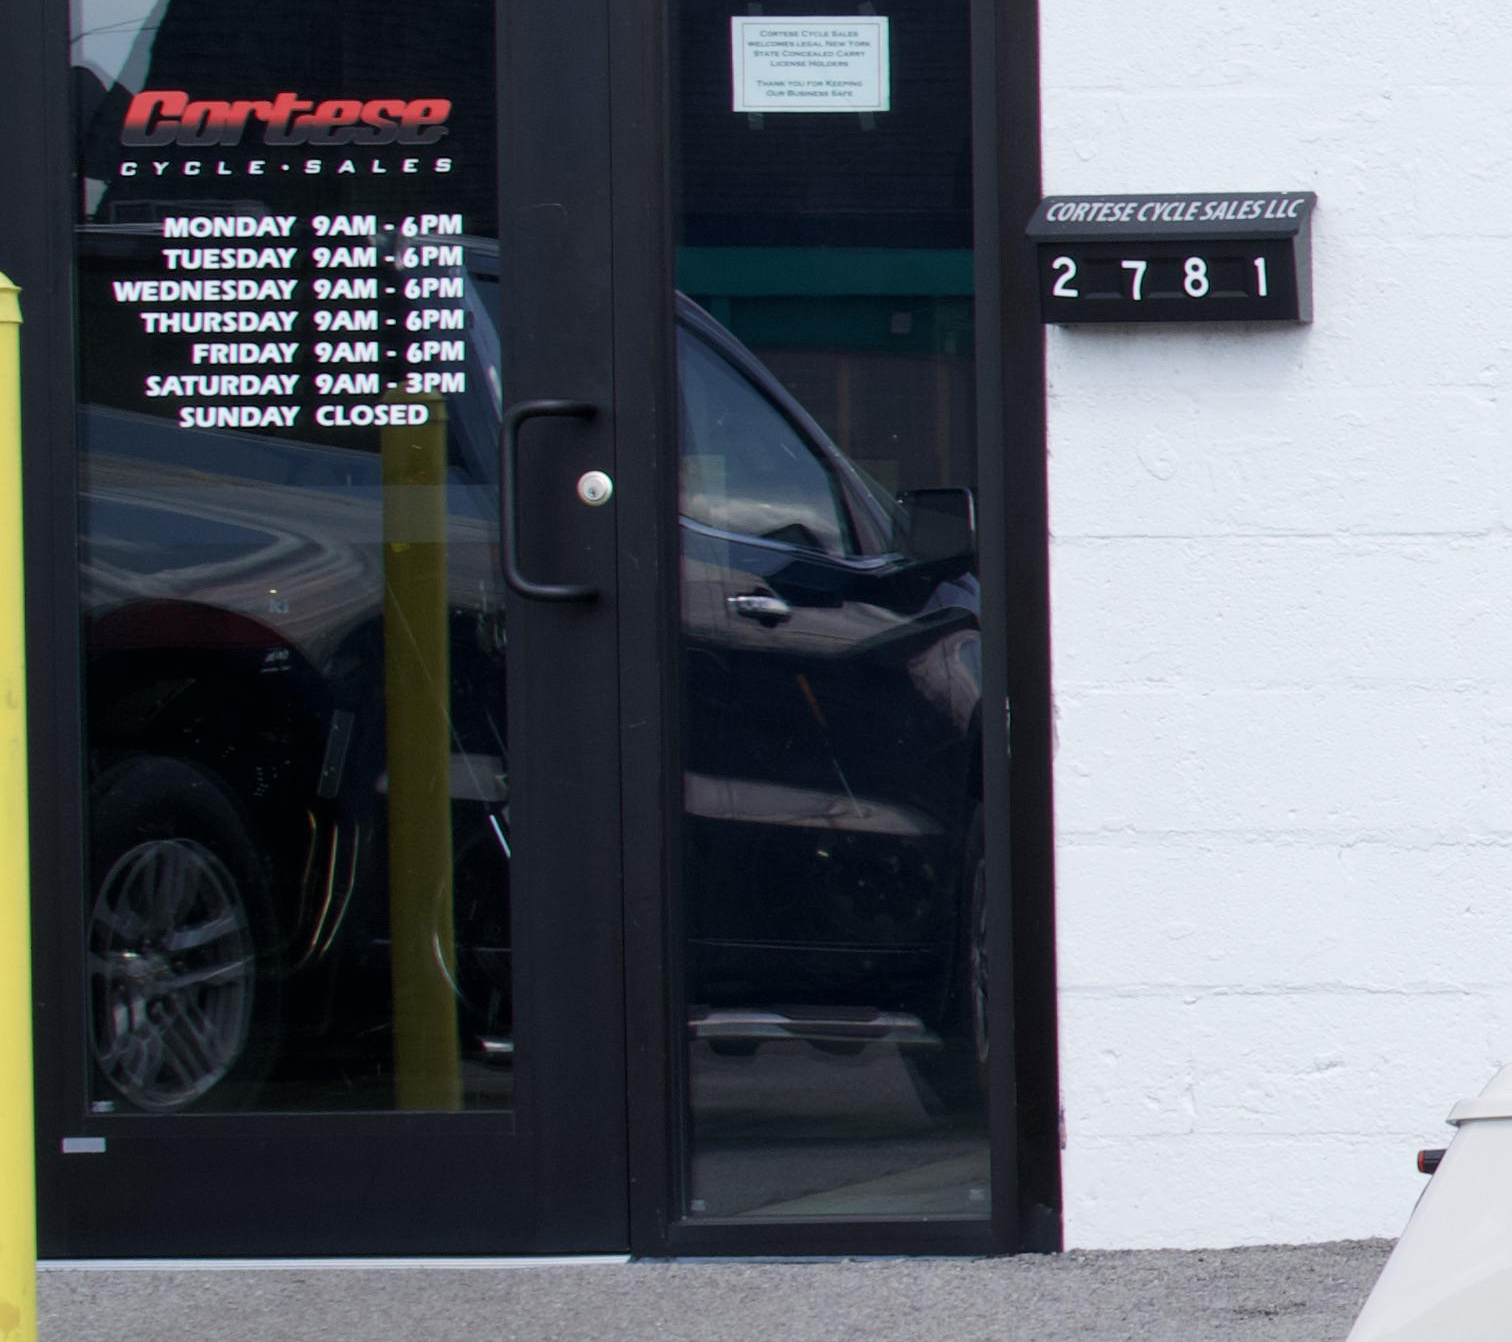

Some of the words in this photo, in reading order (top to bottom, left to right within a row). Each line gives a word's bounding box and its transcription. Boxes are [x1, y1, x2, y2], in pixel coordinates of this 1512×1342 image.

[121, 90, 451, 146] Cortese
[120, 161, 265, 176] CYCLE
[304, 159, 452, 174] SALES
[1046, 202, 1138, 222] CORTESE
[1137, 201, 1200, 222] CYCLE
[1200, 200, 1265, 221] SALES
[1264, 199, 1305, 219] LLC
[163, 217, 297, 238] MONDAY
[312, 215, 376, 235] 9AM
[402, 214, 462, 237] 6PM
[162, 248, 298, 269] TUESDAY
[312, 247, 376, 268] 9AM
[402, 246, 463, 268] 6PM
[113, 280, 298, 301] WEDNESDAY
[313, 279, 377, 300] 9AM
[404, 278, 464, 299] 6PM
[140, 312, 298, 333] THURSDAY
[314, 310, 378, 331] 9AM
[405, 310, 464, 331] 6PM
[192, 343, 299, 364] FRIDAY
[315, 342, 378, 363] 9AM
[406, 341, 465, 363] 6PM
[146, 375, 299, 396] SATURDAY
[315, 374, 379, 394] 9AM
[406, 373, 465, 393] 3PM
[180, 406, 300, 427] SUNDAY
[316, 404, 429, 426] CLOSED
